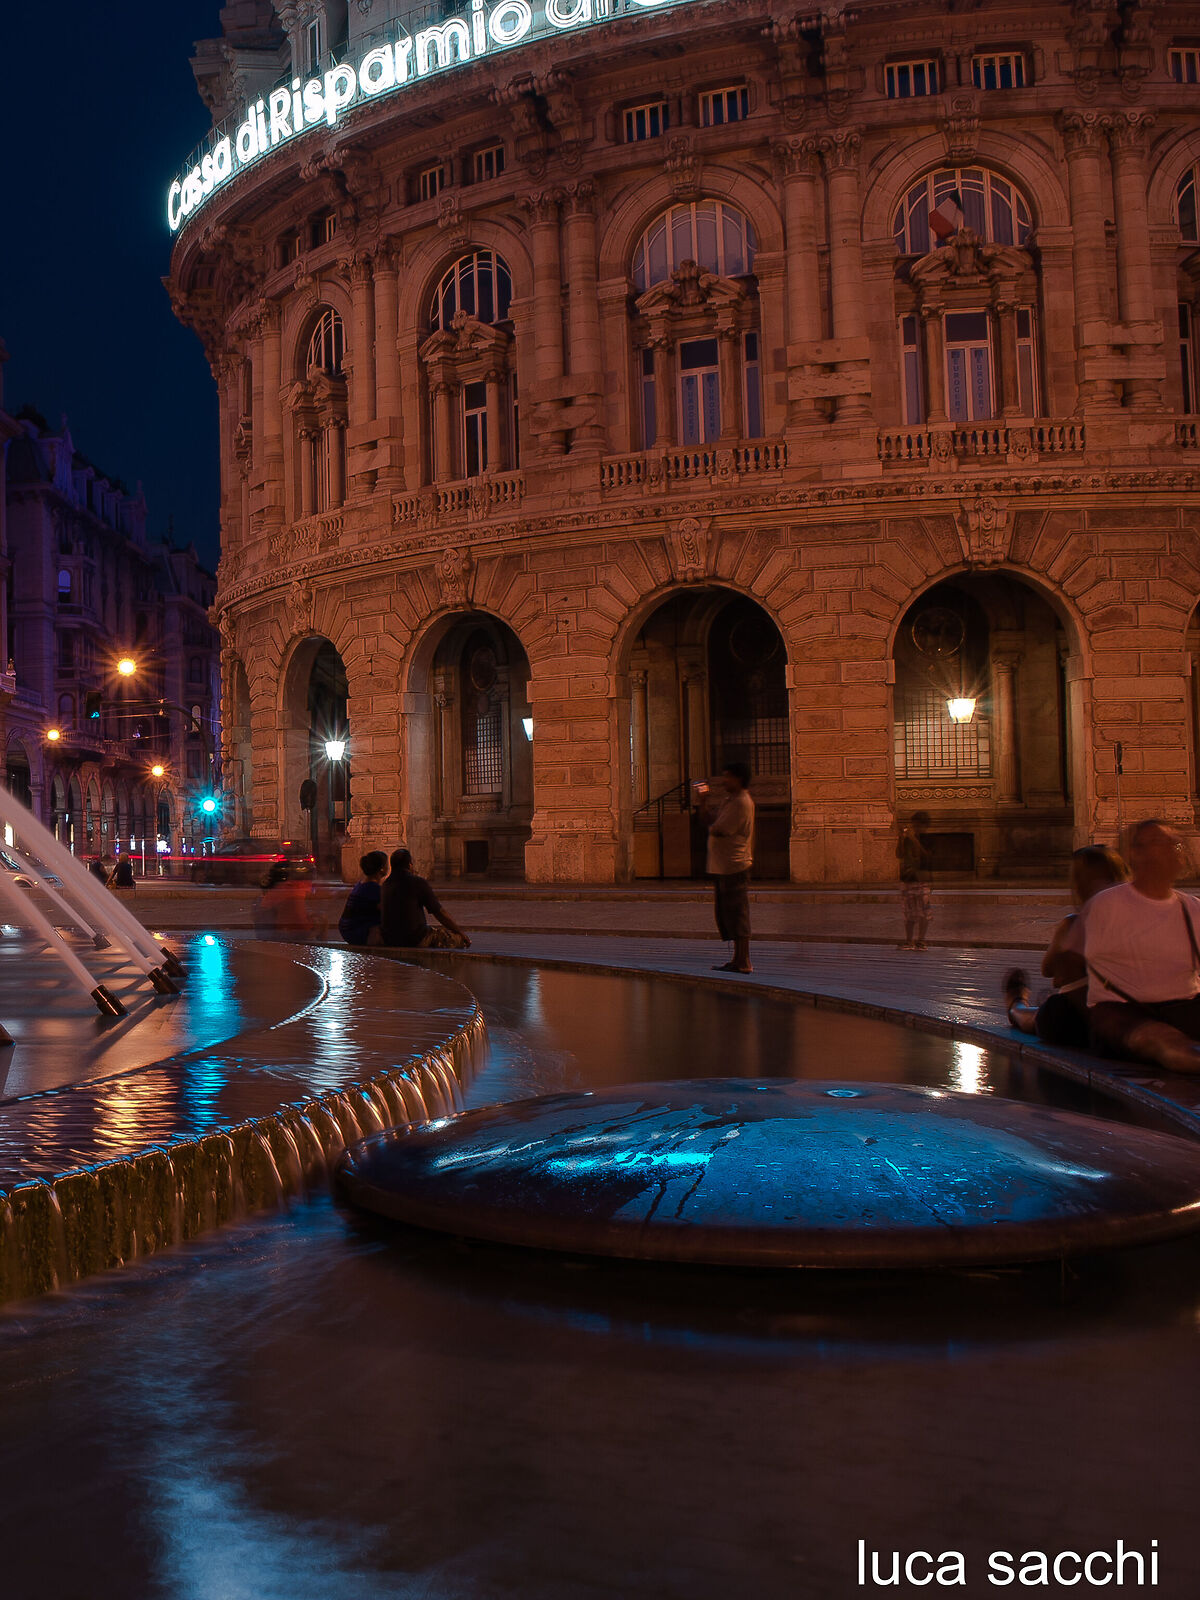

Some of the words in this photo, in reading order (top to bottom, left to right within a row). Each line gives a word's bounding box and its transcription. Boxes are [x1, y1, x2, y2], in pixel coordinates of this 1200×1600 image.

[168, 135, 232, 231] Cassa
[236, 99, 269, 163] di
[269, 0, 533, 145] Risparmio
